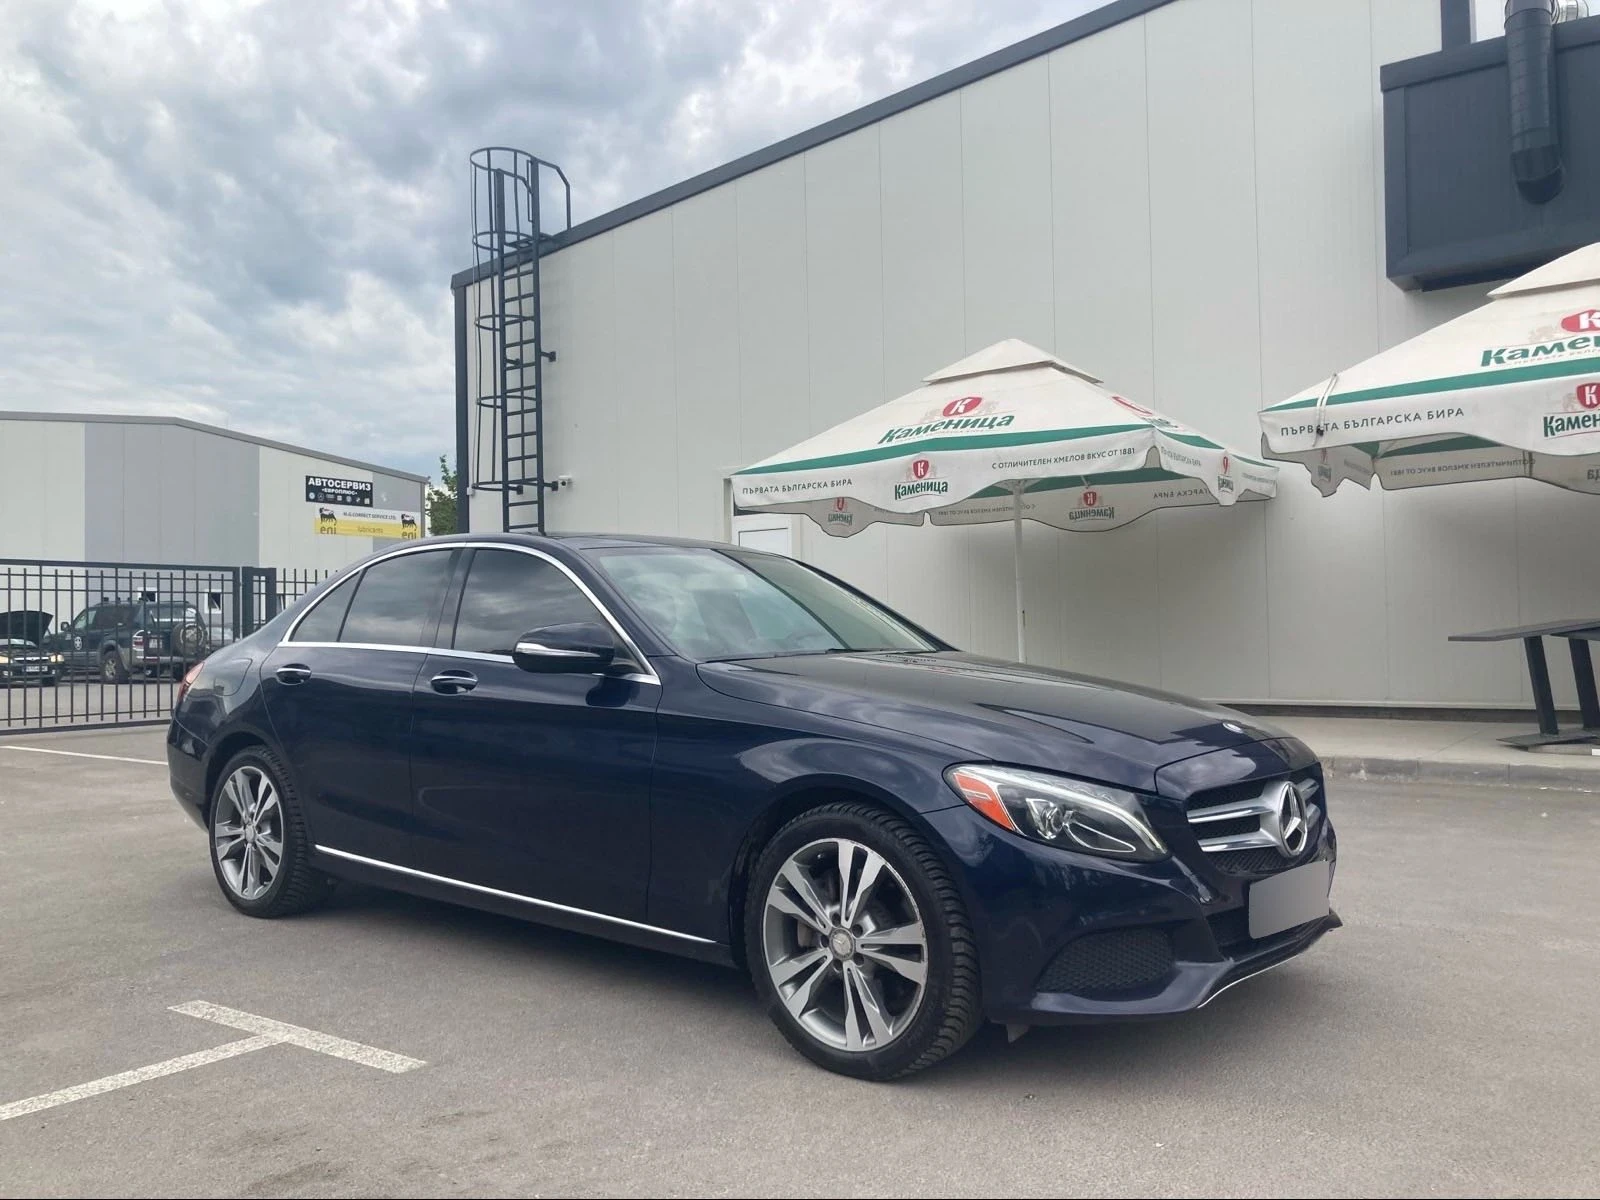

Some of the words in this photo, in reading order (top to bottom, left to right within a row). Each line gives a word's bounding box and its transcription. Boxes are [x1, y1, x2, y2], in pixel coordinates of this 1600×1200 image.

[1343, 412, 1422, 430] БЪЛГАРСКА
[1427, 408, 1465, 420] БИРА
[877, 415, 1015, 444] Каменица
[998, 456, 1053, 469] ОТЛИЧИТЕЛЕН
[1054, 453, 1085, 464] ХМЕЛОВ
[1087, 450, 1107, 460] ВКУС
[1108, 449, 1119, 457] ОТ
[1120, 447, 1136, 456] 1881
[308, 477, 371, 491] АВТОСЕРВИЗ
[742, 486, 780, 495] ПЪРВАТА
[782, 481, 828, 492] БЪЛГАРСКА
[831, 478, 853, 488] БИРА
[894, 481, 948, 500] Каменица
[320, 523, 337, 535] eni
[401, 528, 417, 540] eni
